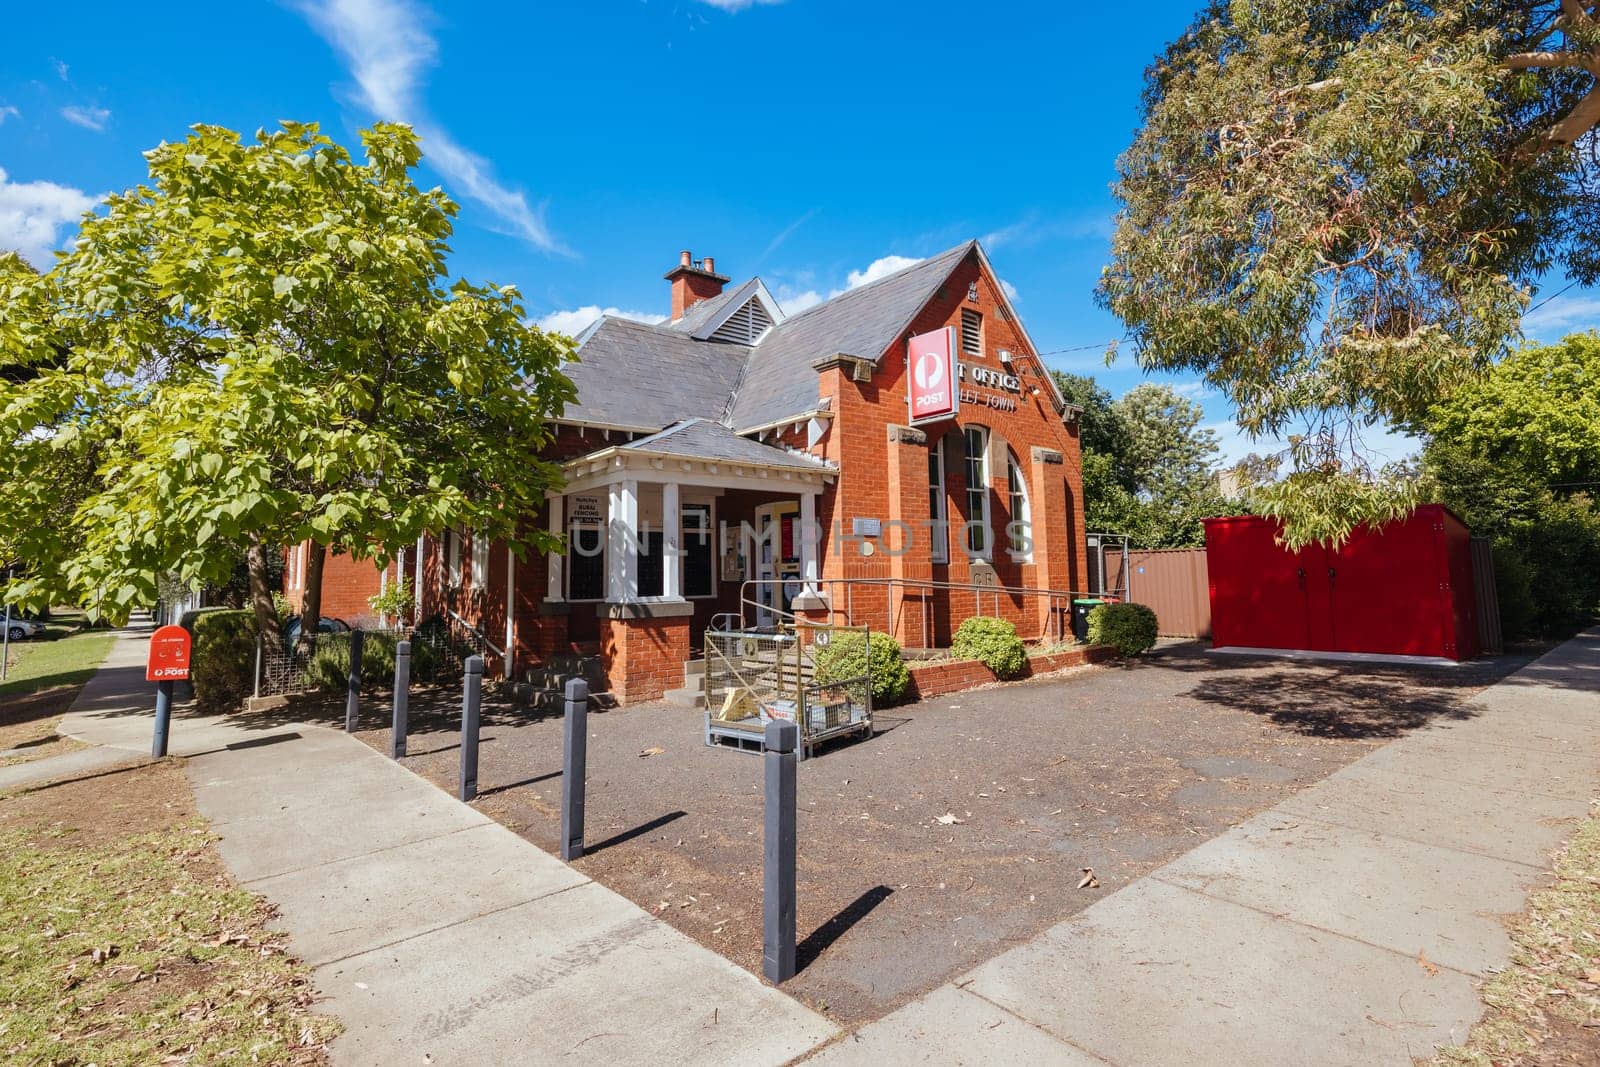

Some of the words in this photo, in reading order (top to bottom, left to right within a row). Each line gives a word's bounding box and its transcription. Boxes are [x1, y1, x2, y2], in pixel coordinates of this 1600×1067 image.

[972, 367, 1020, 390] OFFICE
[916, 392, 944, 408] POST
[959, 388, 980, 404] LET
[984, 393, 1015, 413] TOWN
[164, 668, 189, 676] POST
